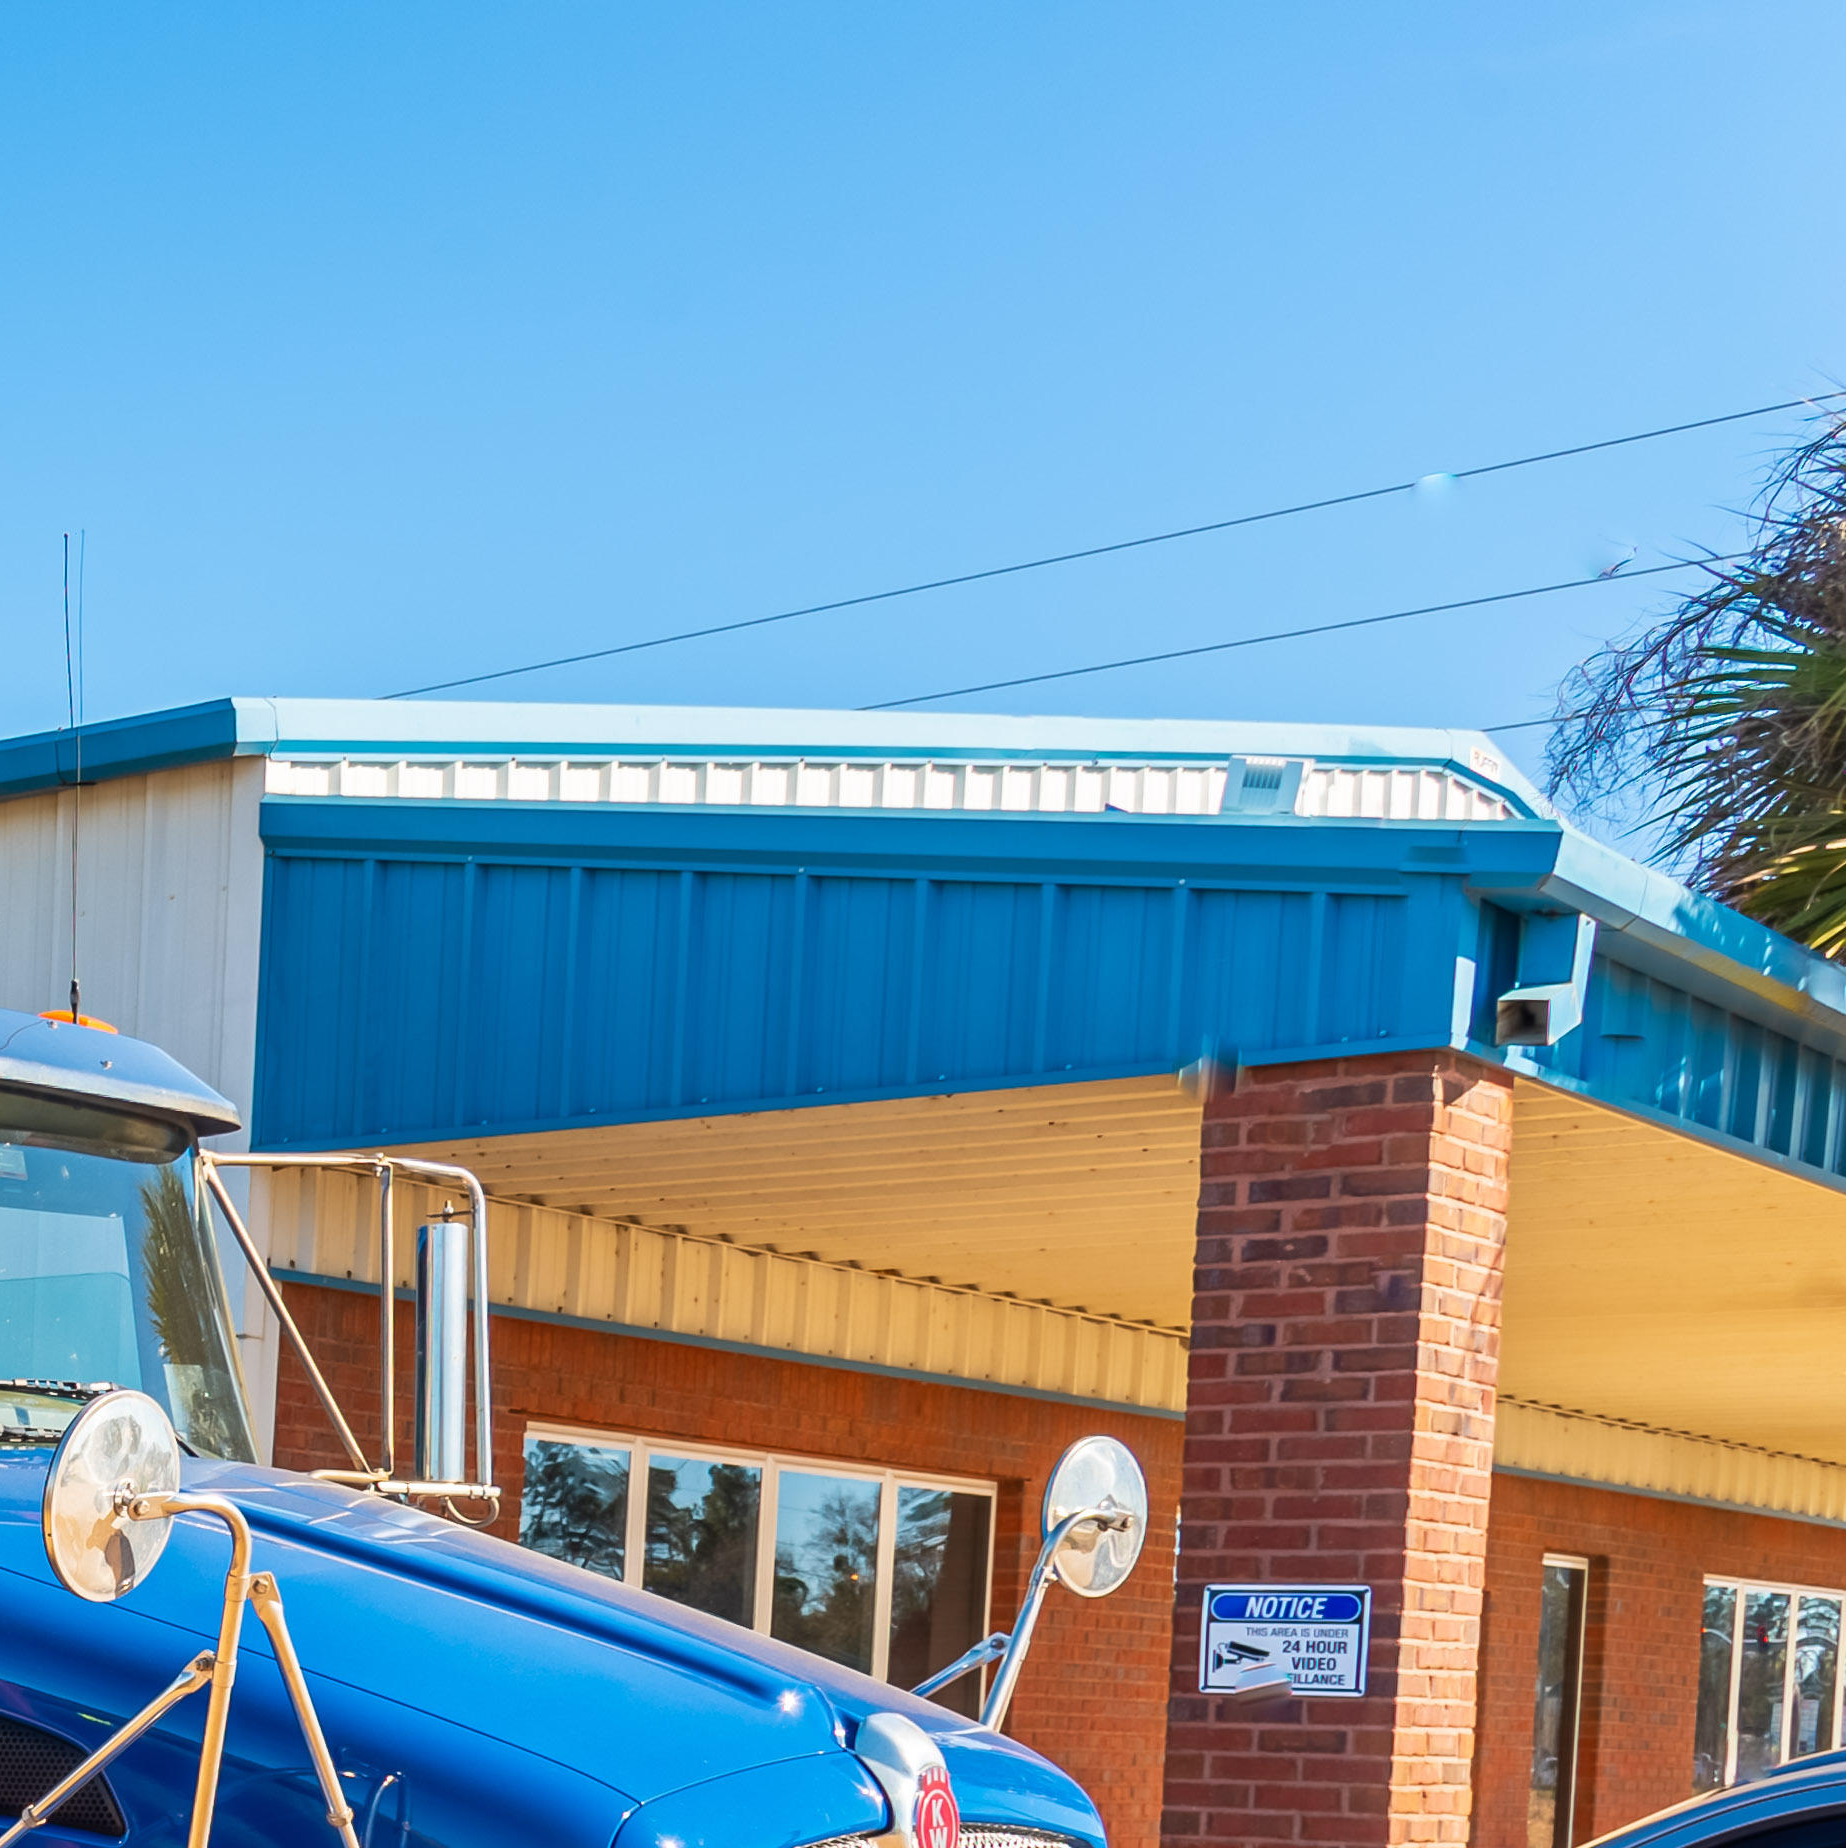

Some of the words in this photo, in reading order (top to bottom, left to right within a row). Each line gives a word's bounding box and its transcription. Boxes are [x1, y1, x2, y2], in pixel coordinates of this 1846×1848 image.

[1244, 1596, 1328, 1619] NOTICE
[1246, 1627, 1268, 1637] THIS
[1270, 1627, 1297, 1637] AREA
[1301, 1628, 1310, 1638] IS
[1313, 1628, 1348, 1638] UNDER
[1282, 1640, 1301, 1653] 24
[1306, 1640, 1347, 1654] HOUR
[1292, 1656, 1337, 1671] VIDEO
